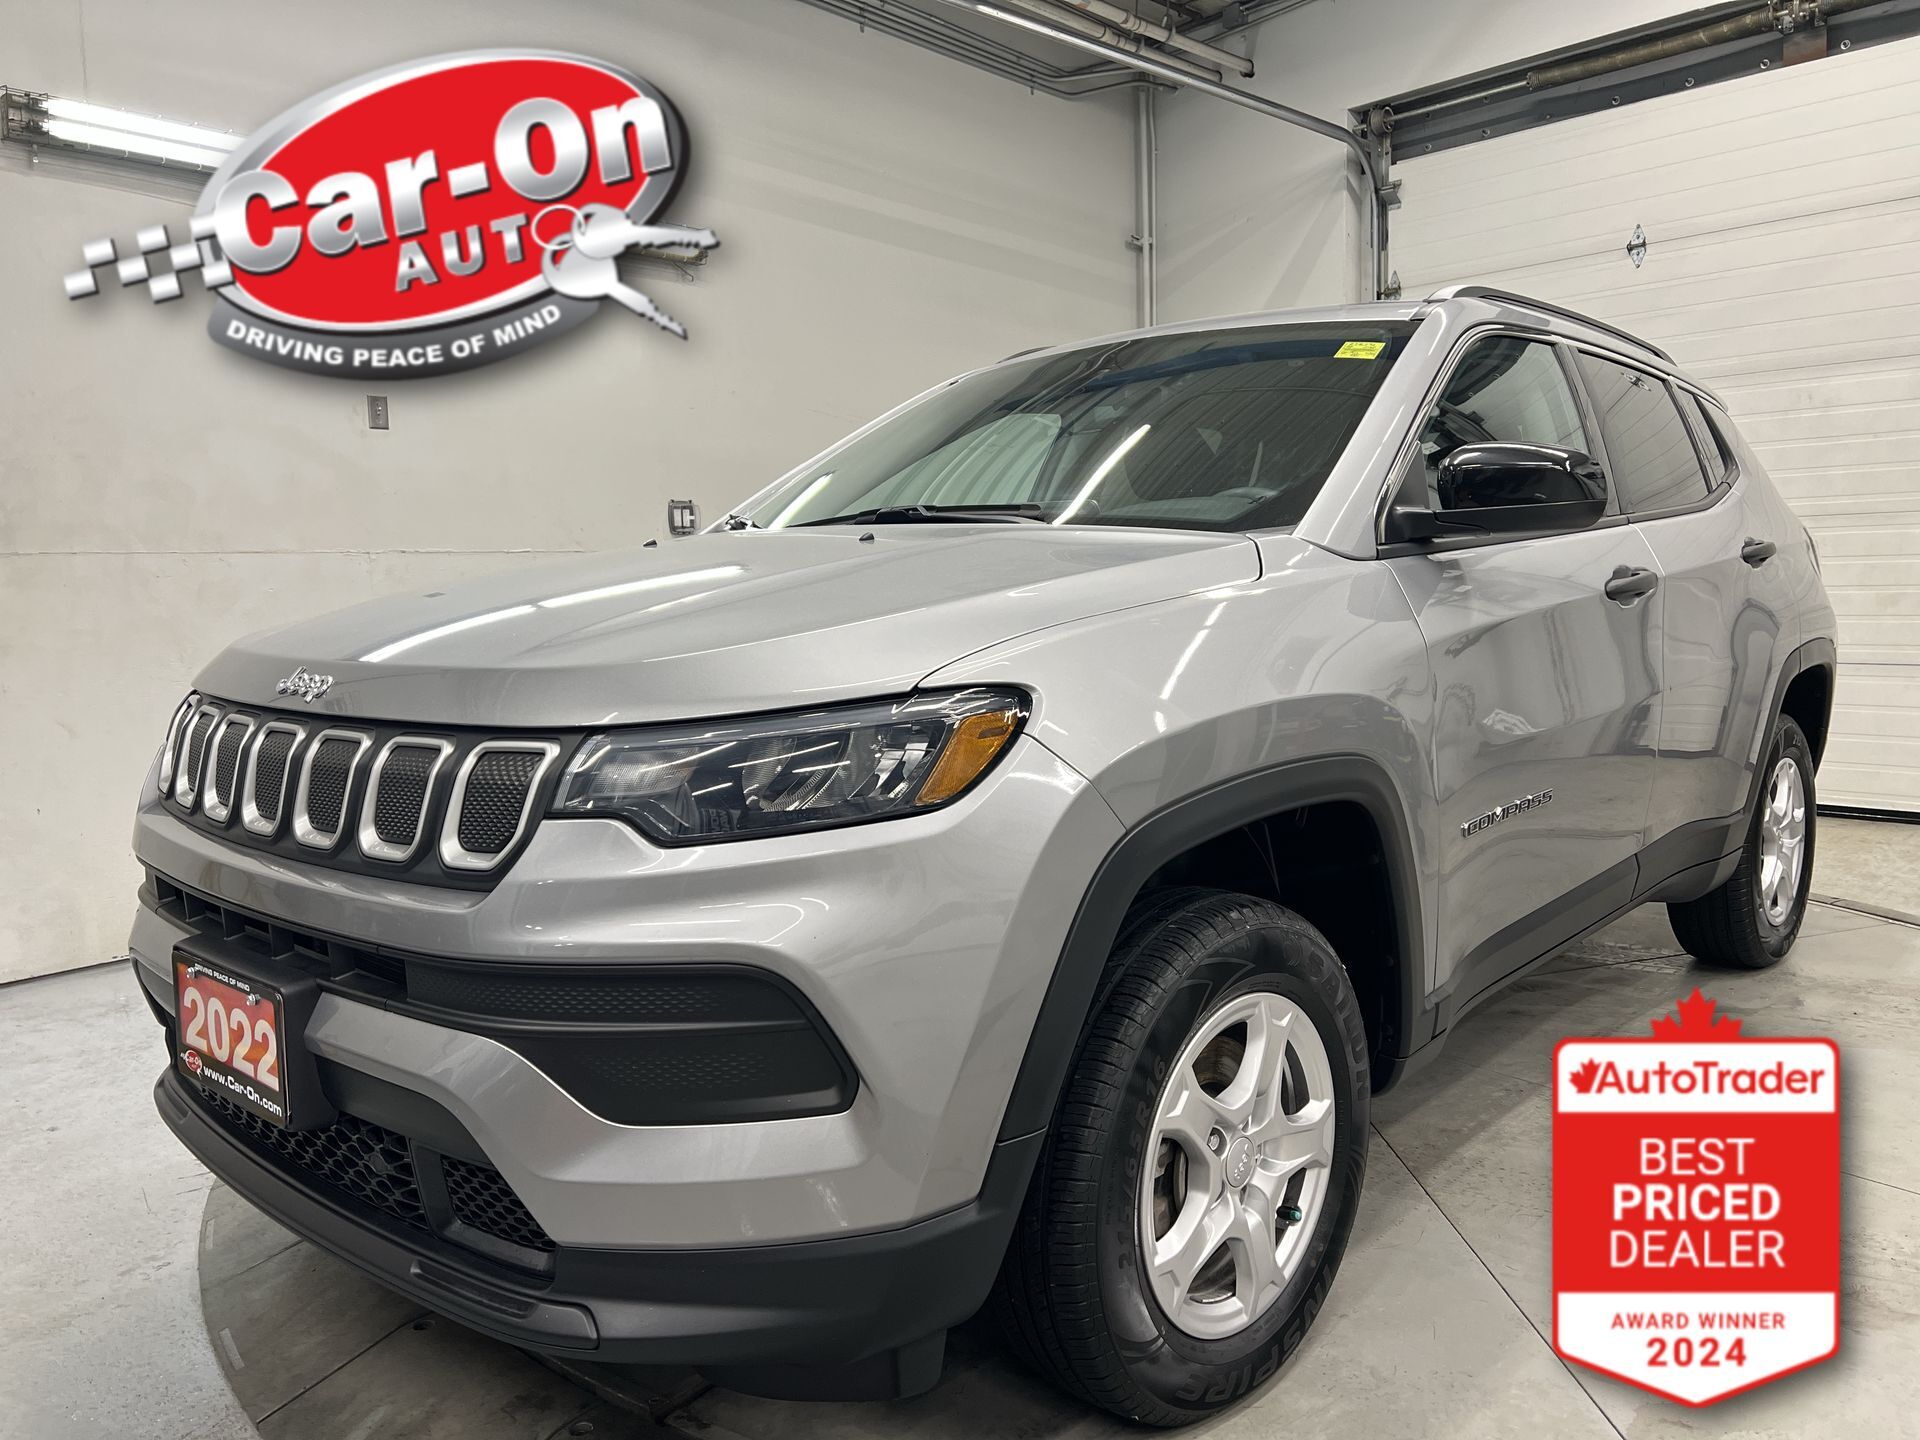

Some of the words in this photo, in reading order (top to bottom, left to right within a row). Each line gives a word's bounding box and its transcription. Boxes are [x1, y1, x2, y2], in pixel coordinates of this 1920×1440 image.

[276, 666, 333, 703] Jeep
[1465, 788, 1554, 837] COMPASS
[184, 986, 280, 1092] 2022
[203, 1065, 283, 1118] www.Car-On.com
